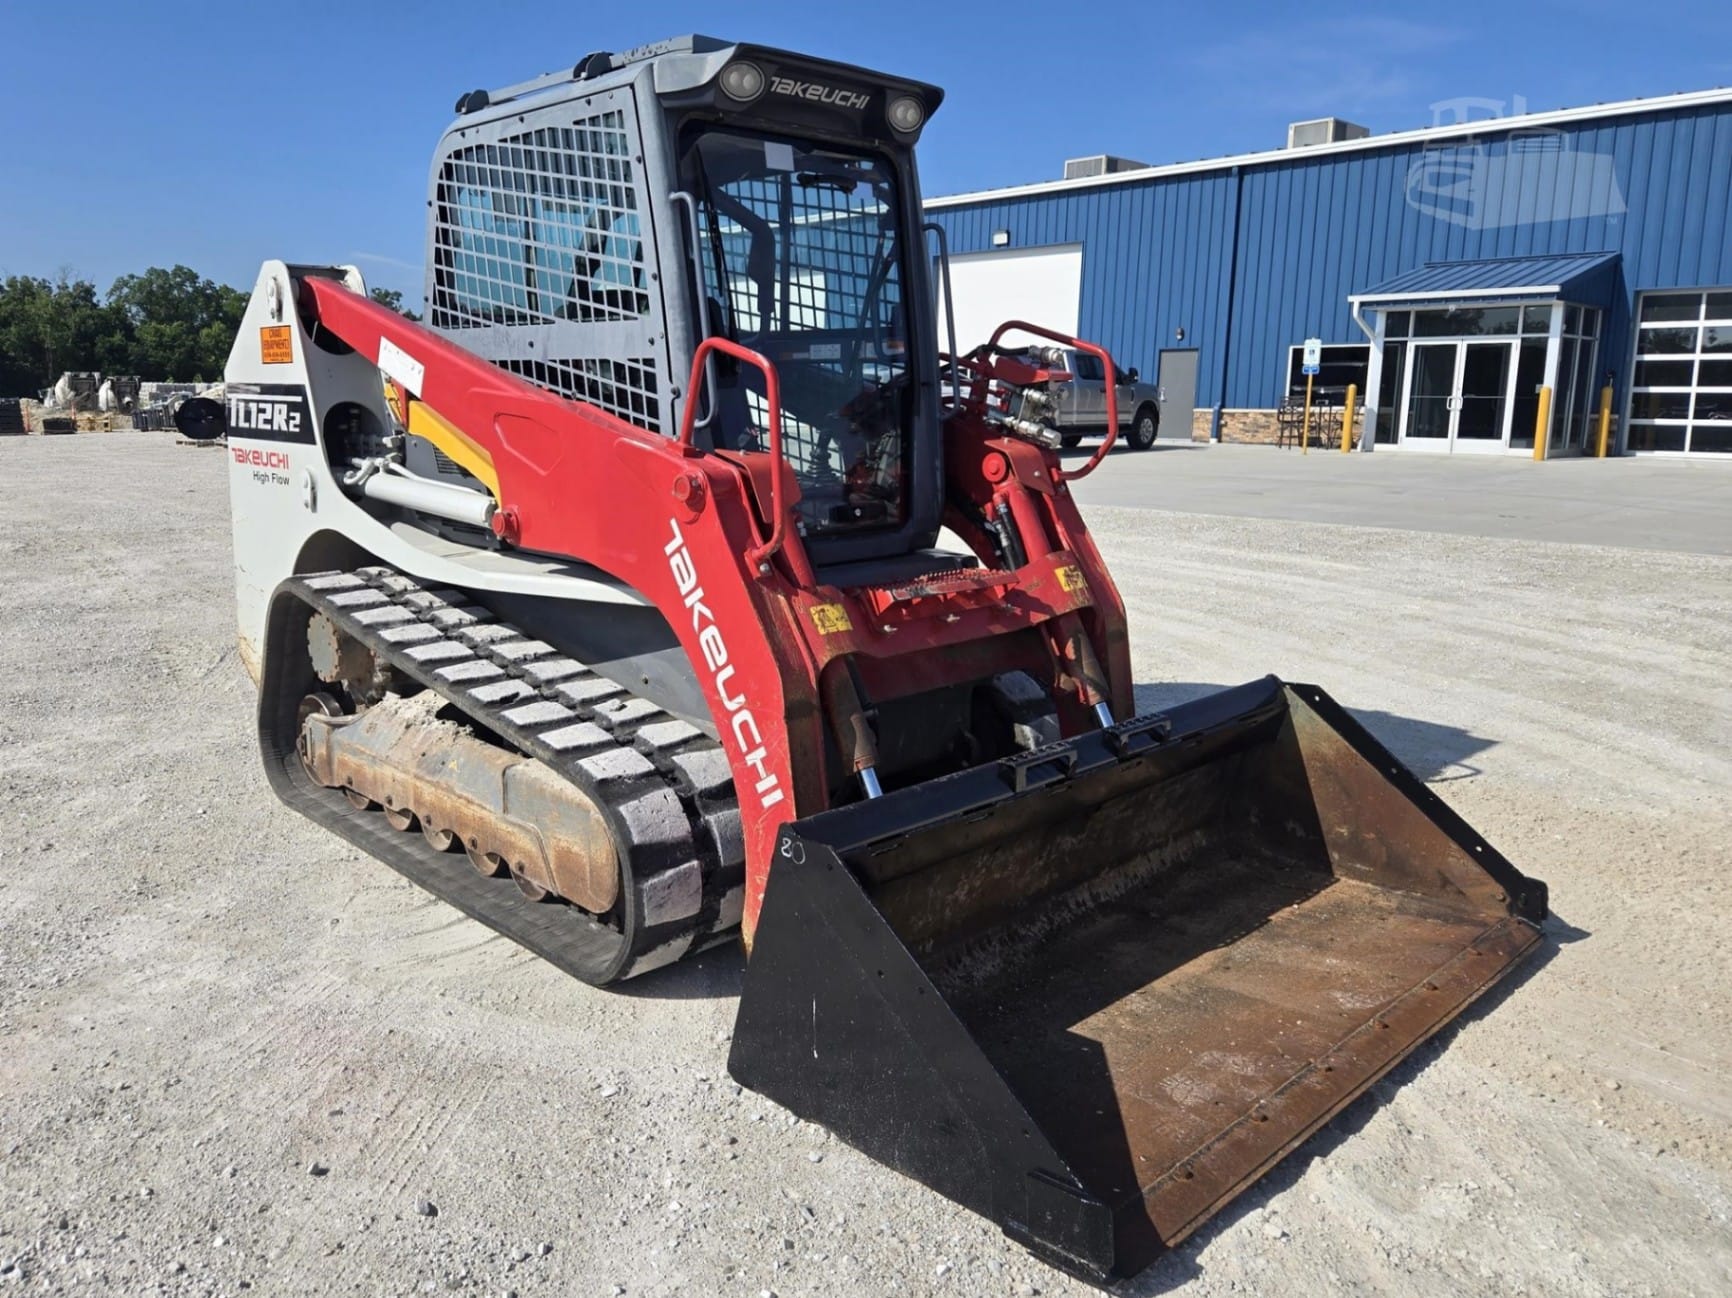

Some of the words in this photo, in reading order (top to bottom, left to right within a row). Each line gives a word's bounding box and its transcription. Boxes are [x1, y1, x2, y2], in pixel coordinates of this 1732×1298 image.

[770, 76, 870, 109] TAKEUCHI
[228, 394, 302, 432] TL12R2
[231, 447, 289, 470] TAKEUCHI
[253, 470, 270, 485] High
[271, 472, 290, 486] Flow
[664, 518, 784, 809] TAKEUCHI
